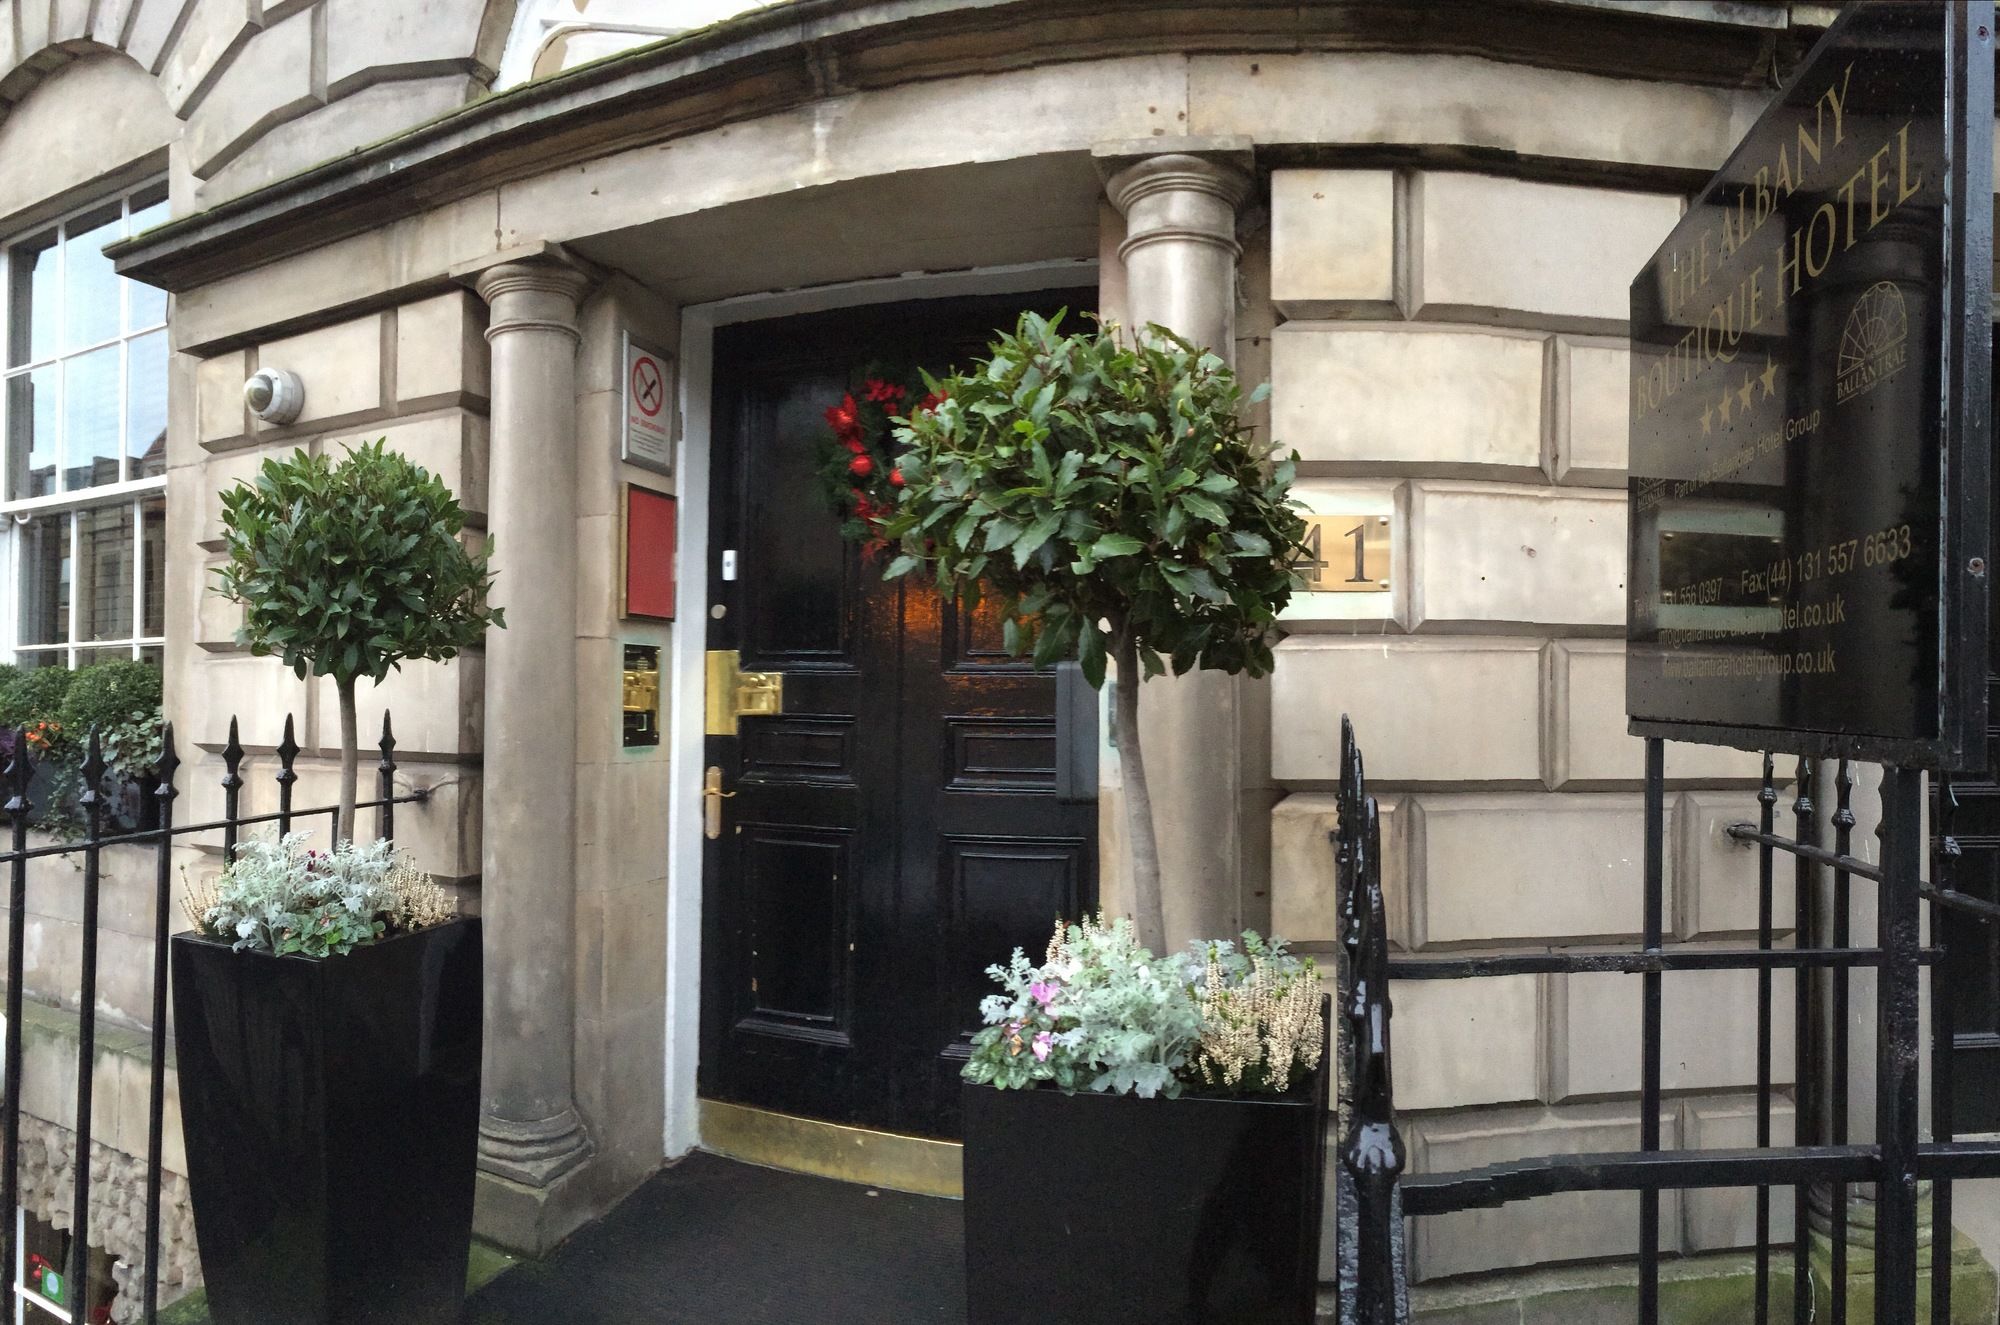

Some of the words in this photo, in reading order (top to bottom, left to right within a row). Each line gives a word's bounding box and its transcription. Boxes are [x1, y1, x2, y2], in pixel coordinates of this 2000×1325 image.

[1665, 228, 1711, 320] THE
[1718, 61, 1855, 270] ALBANY
[1637, 265, 1764, 421] BOUTIQUE
[1775, 120, 1922, 309] HOTEL
[1674, 478, 1689, 501] Part
[1757, 423, 1783, 457] Hotel
[1786, 408, 1821, 441] Group
[1291, 523, 1374, 582] 41
[1679, 584, 1697, 608] 556
[1698, 577, 1723, 606] 0397
[1741, 556, 1792, 597] Fax:(44)
[1797, 548, 1821, 583] 131
[1827, 538, 1858, 576] 557
[1863, 524, 1912, 568] 6633
